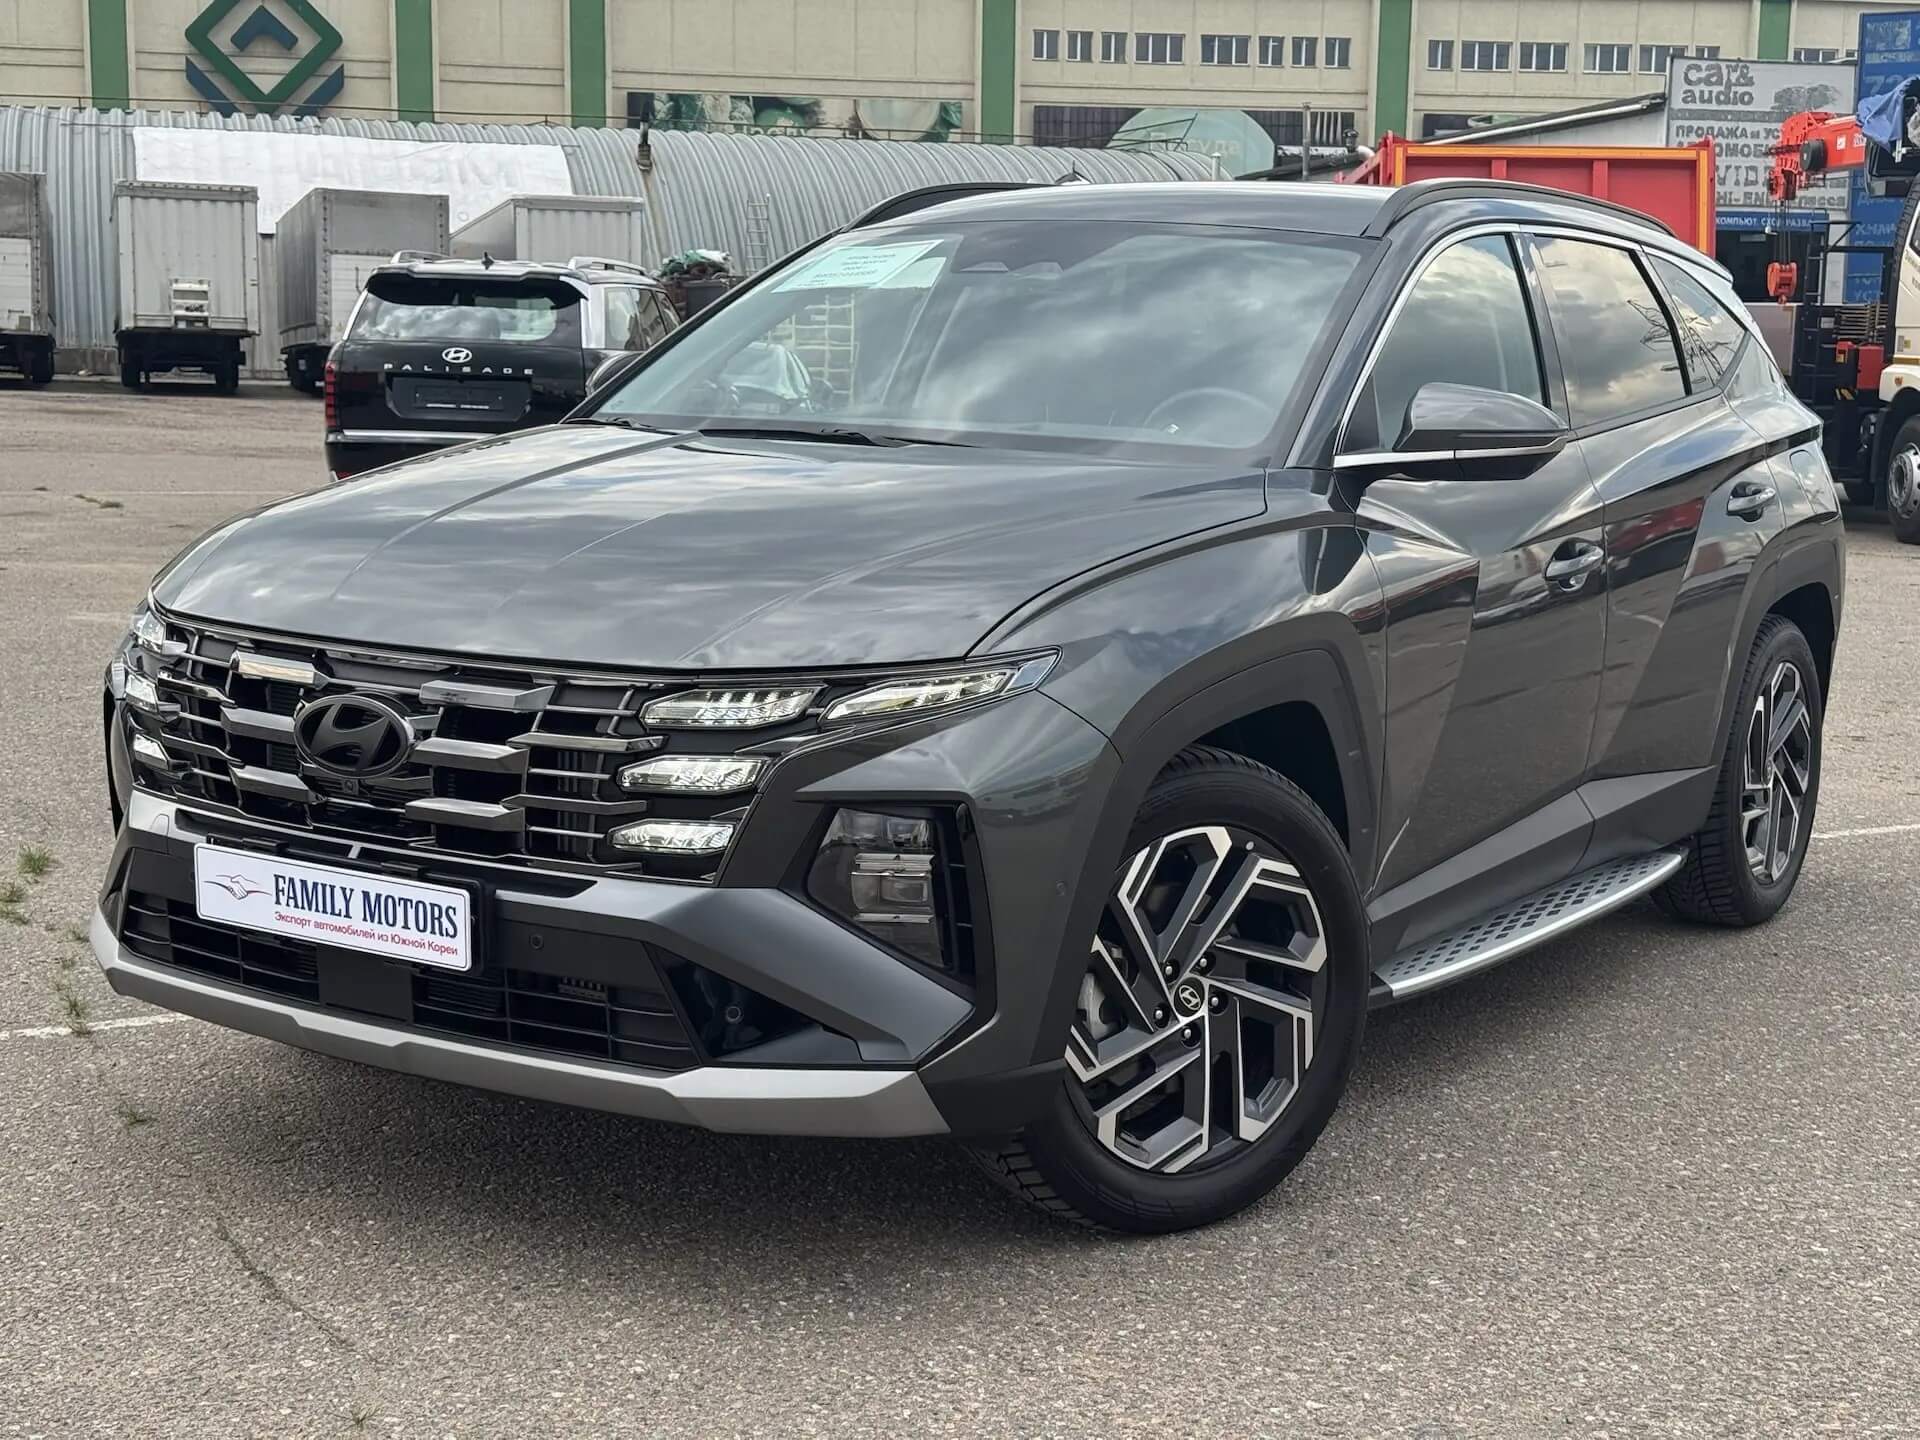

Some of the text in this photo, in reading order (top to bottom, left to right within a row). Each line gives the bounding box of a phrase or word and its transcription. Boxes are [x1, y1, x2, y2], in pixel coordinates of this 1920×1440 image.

[1681, 88, 1754, 106] audio
[1676, 125, 1748, 139] ПРОДАЖА
[383, 363, 533, 375] PALISADE
[273, 874, 458, 939] FAMILY MOTORS
[274, 911, 458, 956] Экспорт автомобилей из Южной Кореи
